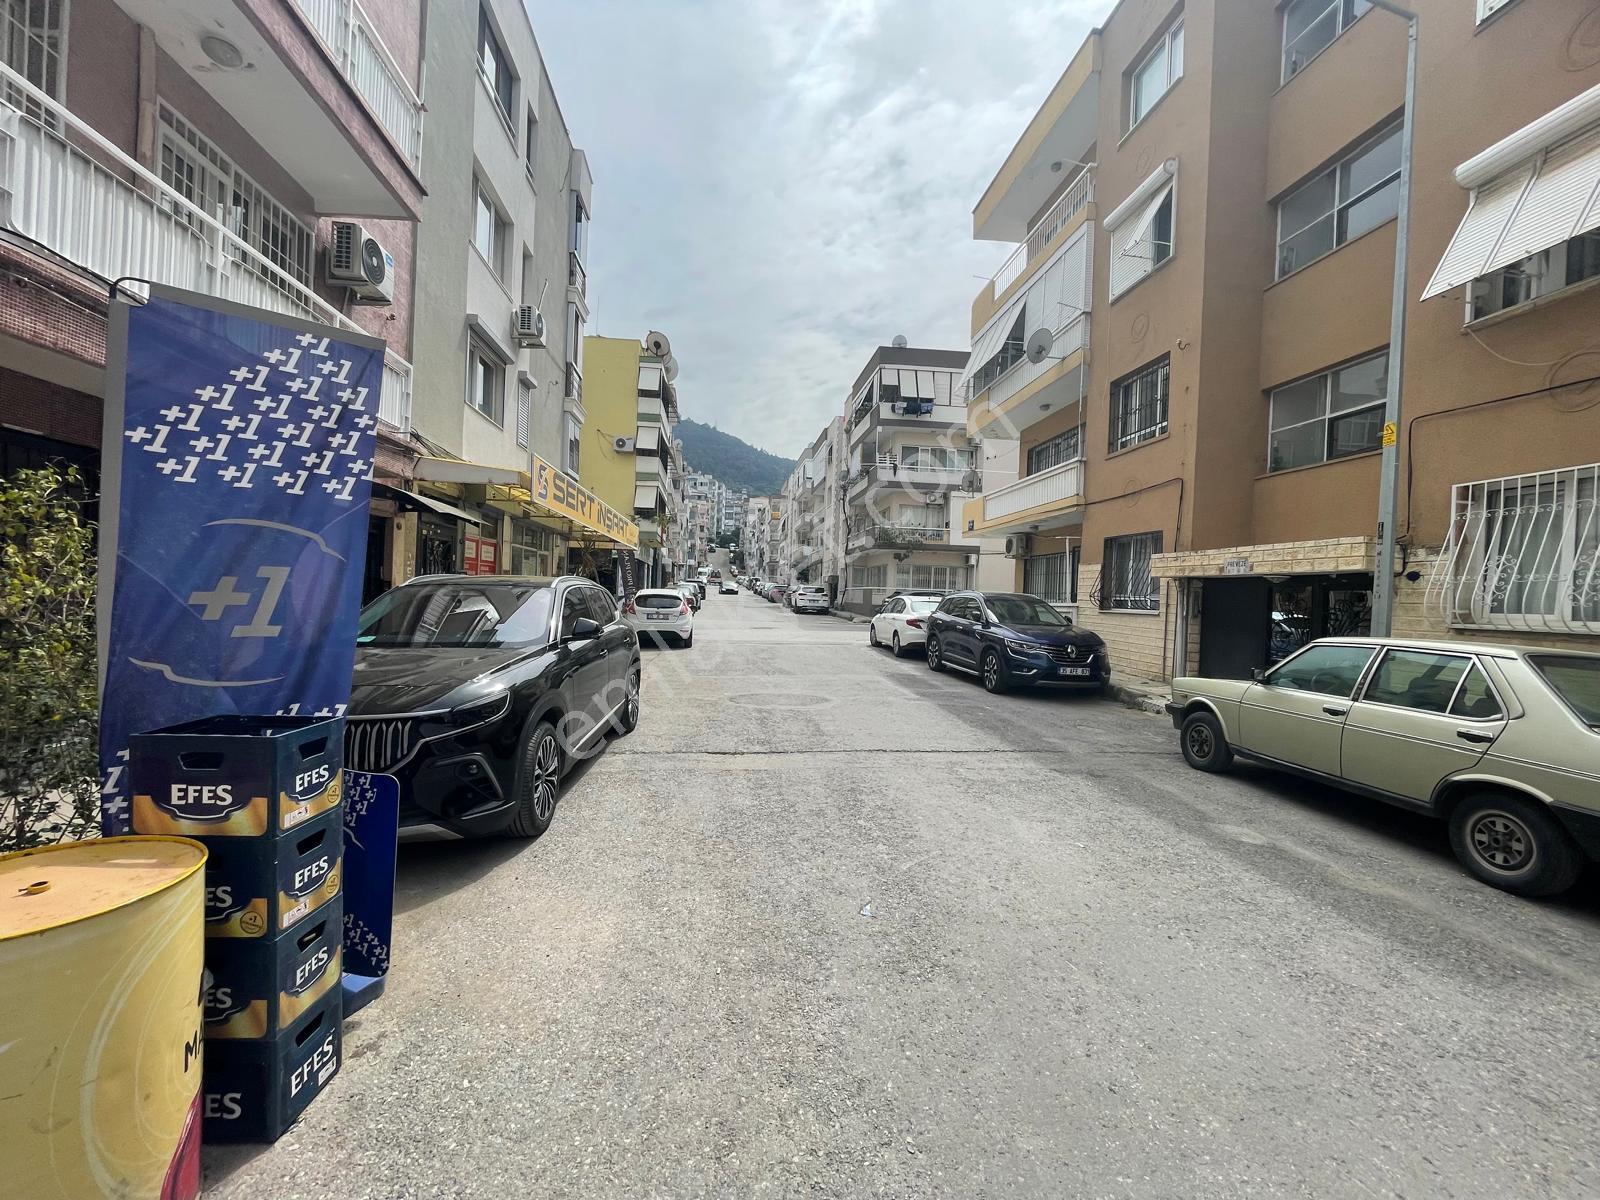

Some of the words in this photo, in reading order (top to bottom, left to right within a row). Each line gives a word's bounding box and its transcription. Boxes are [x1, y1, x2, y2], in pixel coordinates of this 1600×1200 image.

[296, 333, 330, 356] +1
[263, 348, 301, 373] +1
[316, 360, 352, 384] +1
[229, 366, 270, 392] +1
[285, 376, 323, 402] +1
[194, 384, 237, 411] +1
[254, 395, 292, 419] +1
[337, 387, 369, 411] +1
[160, 404, 204, 432] +1
[221, 414, 262, 440] +1
[307, 404, 344, 429] +1
[124, 425, 171, 453] +1
[189, 434, 233, 461] +1
[277, 422, 315, 448] +1
[328, 431, 360, 456] +1
[248, 441, 286, 467] +1
[301, 451, 334, 475] +1
[156, 456, 200, 483] +1
[218, 463, 257, 488] +1
[272, 470, 308, 495] +1
[321, 477, 356, 500] +1
[553, 471, 595, 519] SERT
[188, 566, 292, 637] +1
[296, 764, 329, 793] EFES
[359, 775, 371, 788] +1
[171, 784, 232, 806] EFES
[349, 787, 360, 800] +1
[345, 812, 356, 826] +1
[355, 801, 368, 815] +1
[295, 856, 328, 890] EFES
[205, 885, 233, 908] ES
[349, 928, 361, 942] +1
[374, 945, 387, 958] +1
[296, 946, 328, 987] EFES
[290, 1034, 334, 1098] EFES
[205, 1092, 242, 1120] ES
